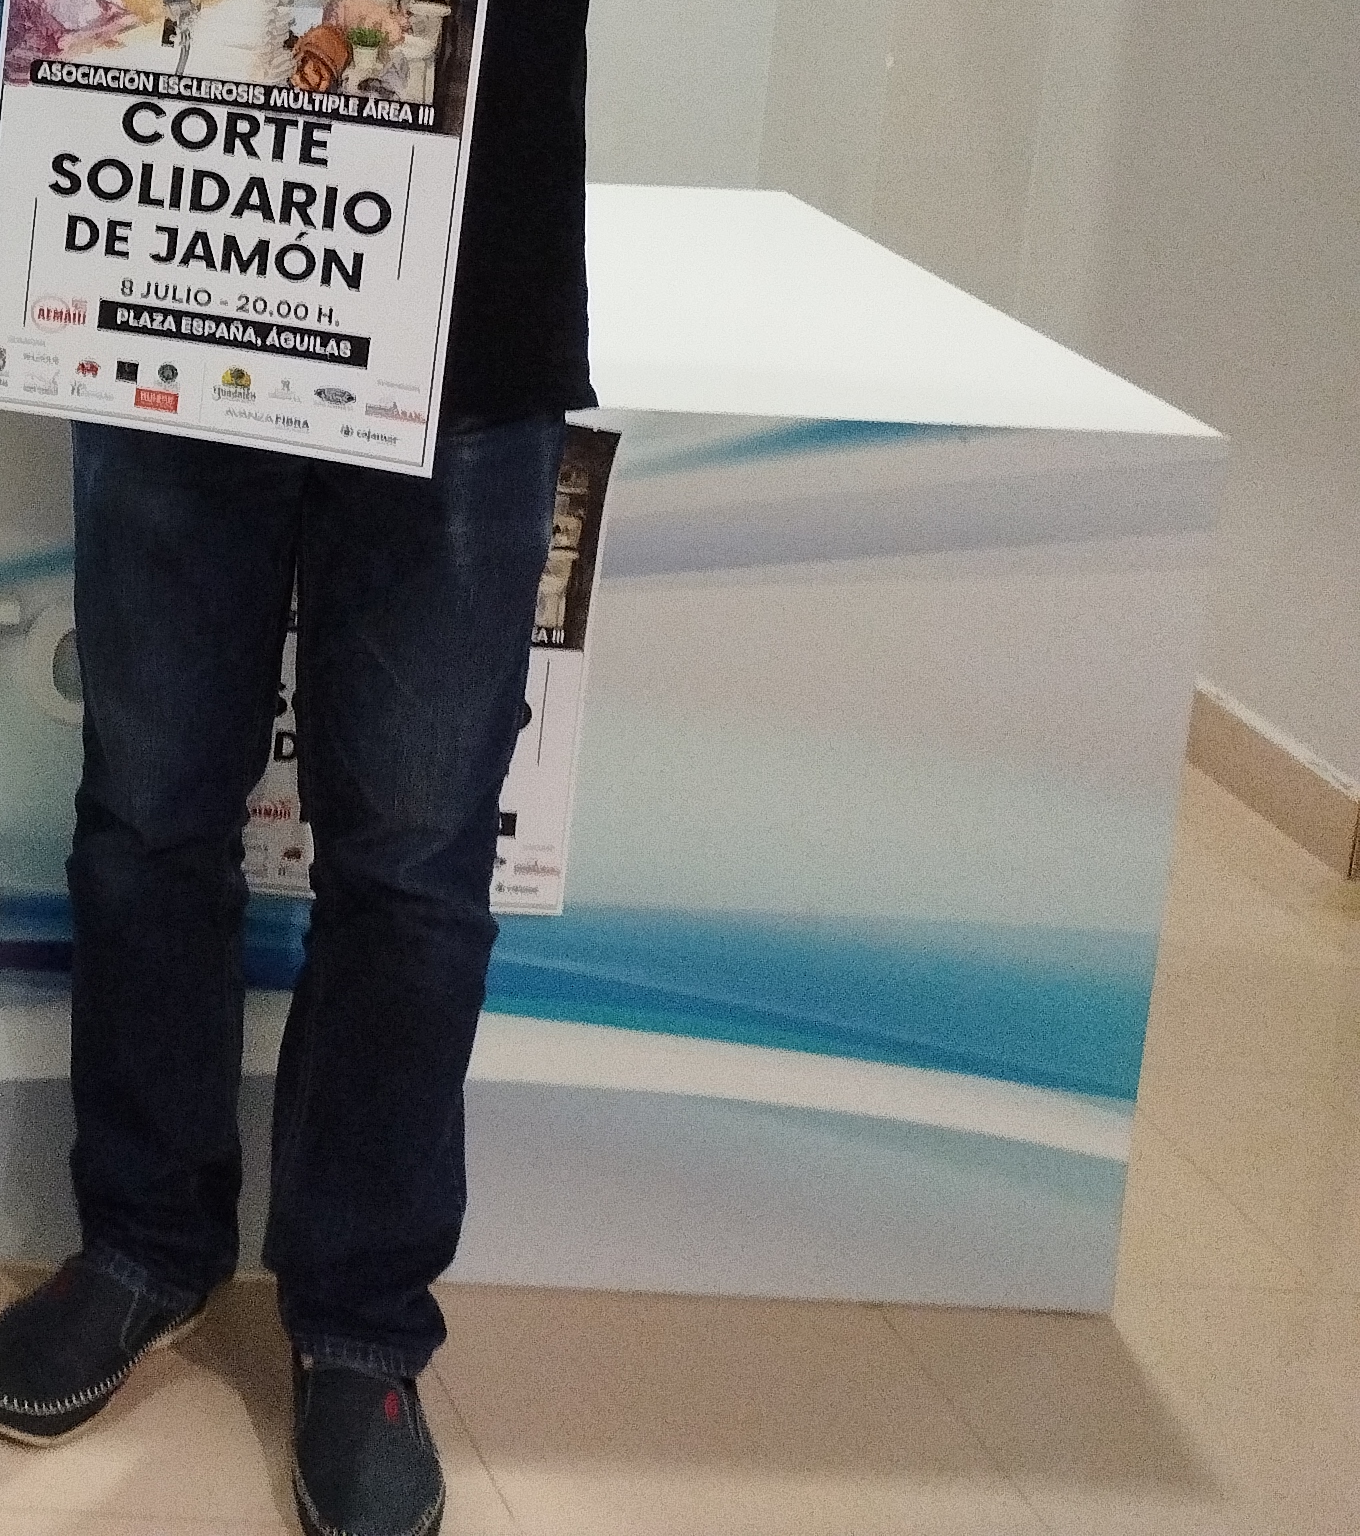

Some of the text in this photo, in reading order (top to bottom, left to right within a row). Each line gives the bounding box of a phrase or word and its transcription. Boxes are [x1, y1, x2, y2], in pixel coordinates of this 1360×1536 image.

[37, 61, 435, 125] ASOCIACIÓN ESCLEROSIS MÚLTIPLE ÁREA III
[121, 101, 332, 168] CORTE
[49, 152, 393, 236] SOLIDARIO
[64, 213, 365, 293] DE JAMÓN
[116, 307, 352, 359] PLAZA ESPAÑA, ÁGUILAS
[120, 276, 134, 297] 8
[140, 281, 212, 307] JULIO
[235, 293, 309, 322] 20.00
[317, 305, 340, 328] H.
